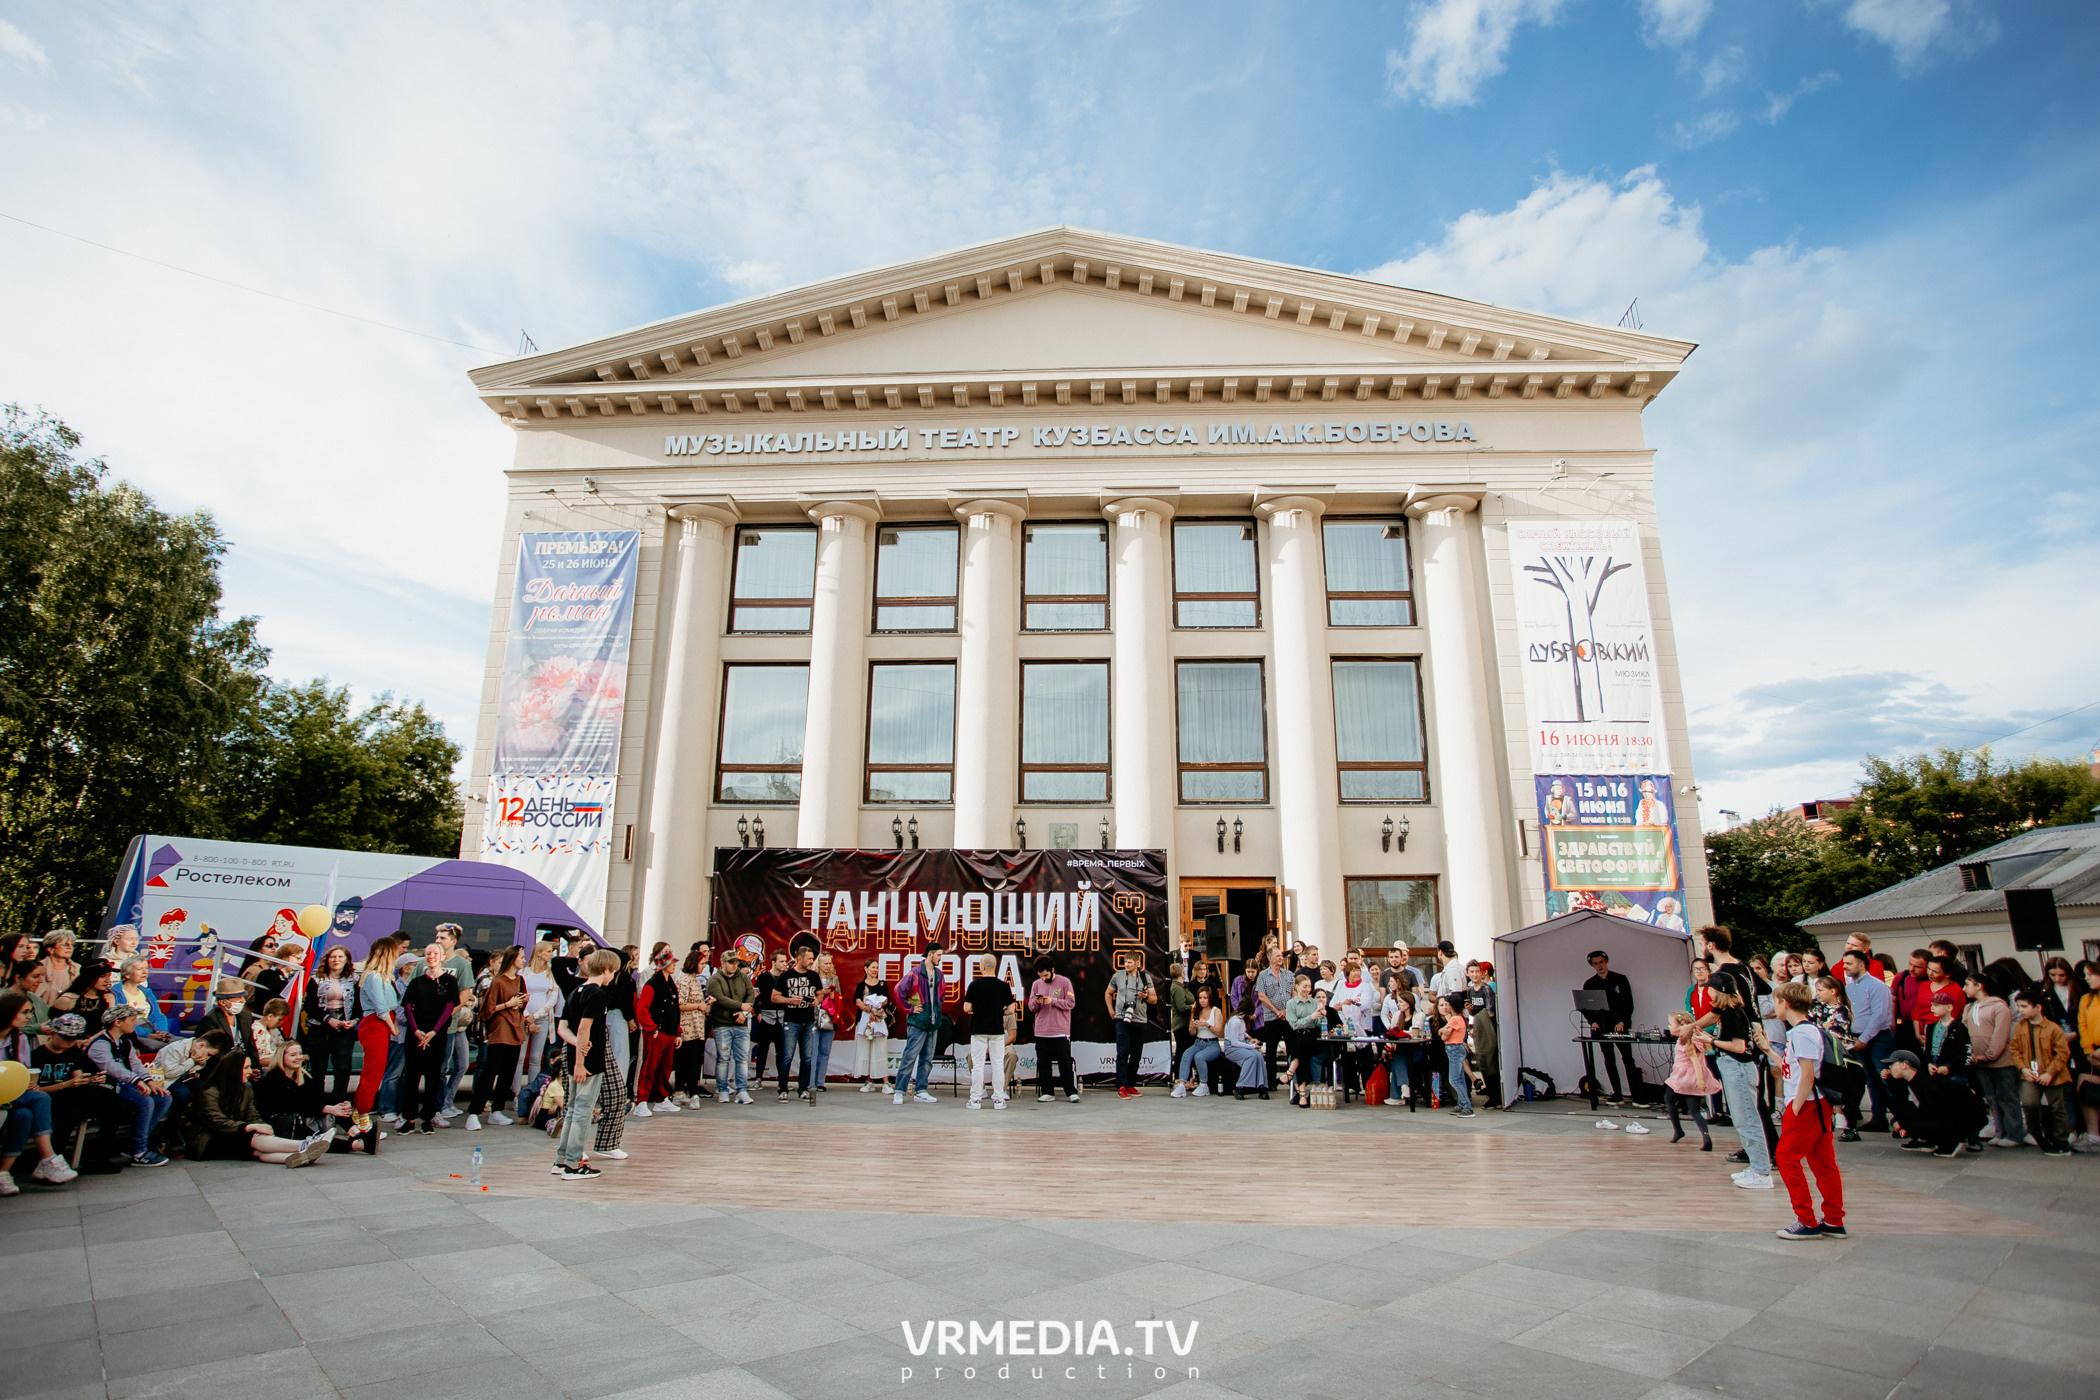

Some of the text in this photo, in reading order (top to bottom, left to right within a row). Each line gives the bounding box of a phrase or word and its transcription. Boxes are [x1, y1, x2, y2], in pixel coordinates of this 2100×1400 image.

[664, 425, 910, 456] МУЗЫКАЛЬНЫЙ
[919, 427, 1020, 449] ТЕАТР
[1032, 423, 1199, 448] КУЗБАССА
[534, 540, 624, 555] ПРЕМЬЕРА!
[542, 559, 556, 569] 25
[566, 559, 580, 569] 26
[581, 558, 617, 569] ИЮНЯ
[522, 577, 625, 604] Дачный
[524, 604, 613, 631] роман
[1530, 635, 1650, 662] ДУБРОВСКИЙ
[1615, 670, 1650, 678] МЮЗИКЛ
[1540, 730, 1653, 746] 16 ИЮНЯ 18:30
[1576, 782, 1628, 798] 15 и 16
[499, 797, 525, 822] 12
[524, 797, 576, 812] ДЕНЬ
[1579, 801, 1626, 814] ИЮНЯ
[496, 819, 523, 828] ИЮНЯ
[521, 812, 602, 828] РОССИИ
[1558, 839, 1661, 858] ЗДРАВСТВУЙ,
[193, 855, 267, 867] 8-800-100-0-800
[1066, 859, 1145, 868] #ВРЕМЯ_ПЕРВЫХ
[1557, 859, 1665, 874] СВЕТОФОРИК!
[175, 868, 291, 888] Ростелеком
[803, 880, 1099, 938] ТАНЦУЮЩИЙ
